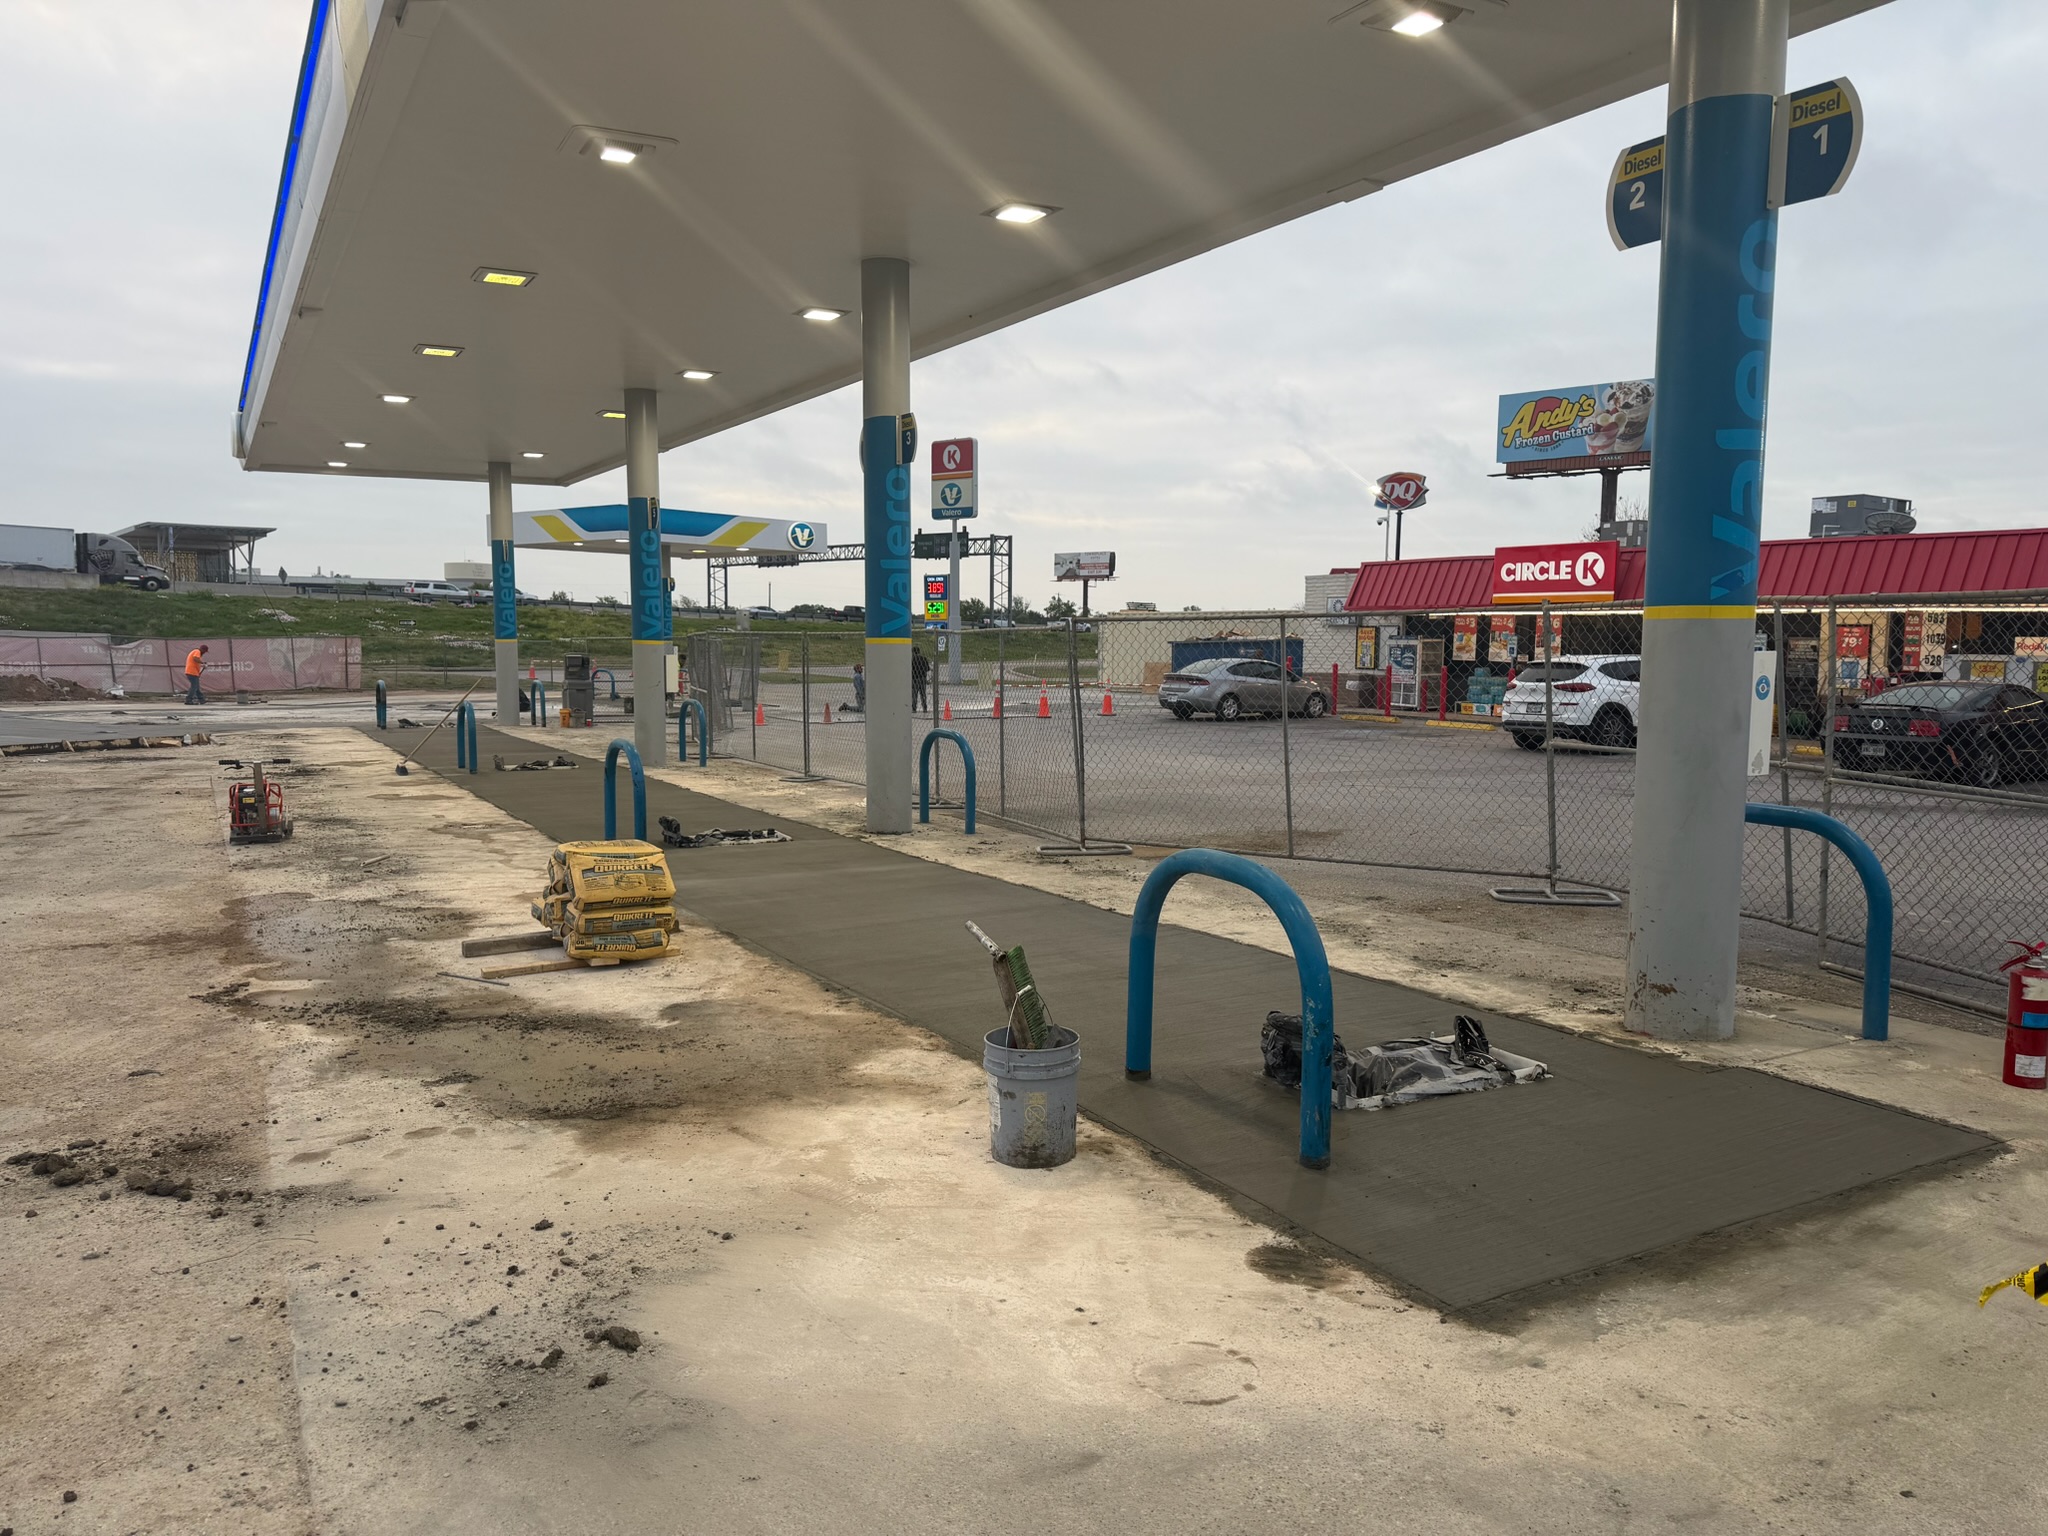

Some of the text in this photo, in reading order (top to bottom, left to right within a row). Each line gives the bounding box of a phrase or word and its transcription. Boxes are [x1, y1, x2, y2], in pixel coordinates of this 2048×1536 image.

[1792, 91, 1842, 123] Diesel
[1812, 123, 1829, 156] 1
[1624, 148, 1662, 176] Diesel
[1629, 180, 1646, 211] 2
[1502, 393, 1596, 448] Andy's
[1710, 218, 1777, 600] Valero
[906, 431, 912, 446] 3
[1514, 423, 1595, 449] Frozen Custard
[1384, 480, 1416, 501] DQ
[941, 509, 962, 517] Valero
[880, 466, 911, 636] Valero
[640, 529, 662, 639] Valero
[1500, 554, 1604, 585] CIRCLE K
[500, 562, 516, 638] Valero
[594, 863, 654, 873] QUIKRETE
[613, 896, 655, 904] QUIKRETE
[613, 912, 655, 921] QUIKRETE
